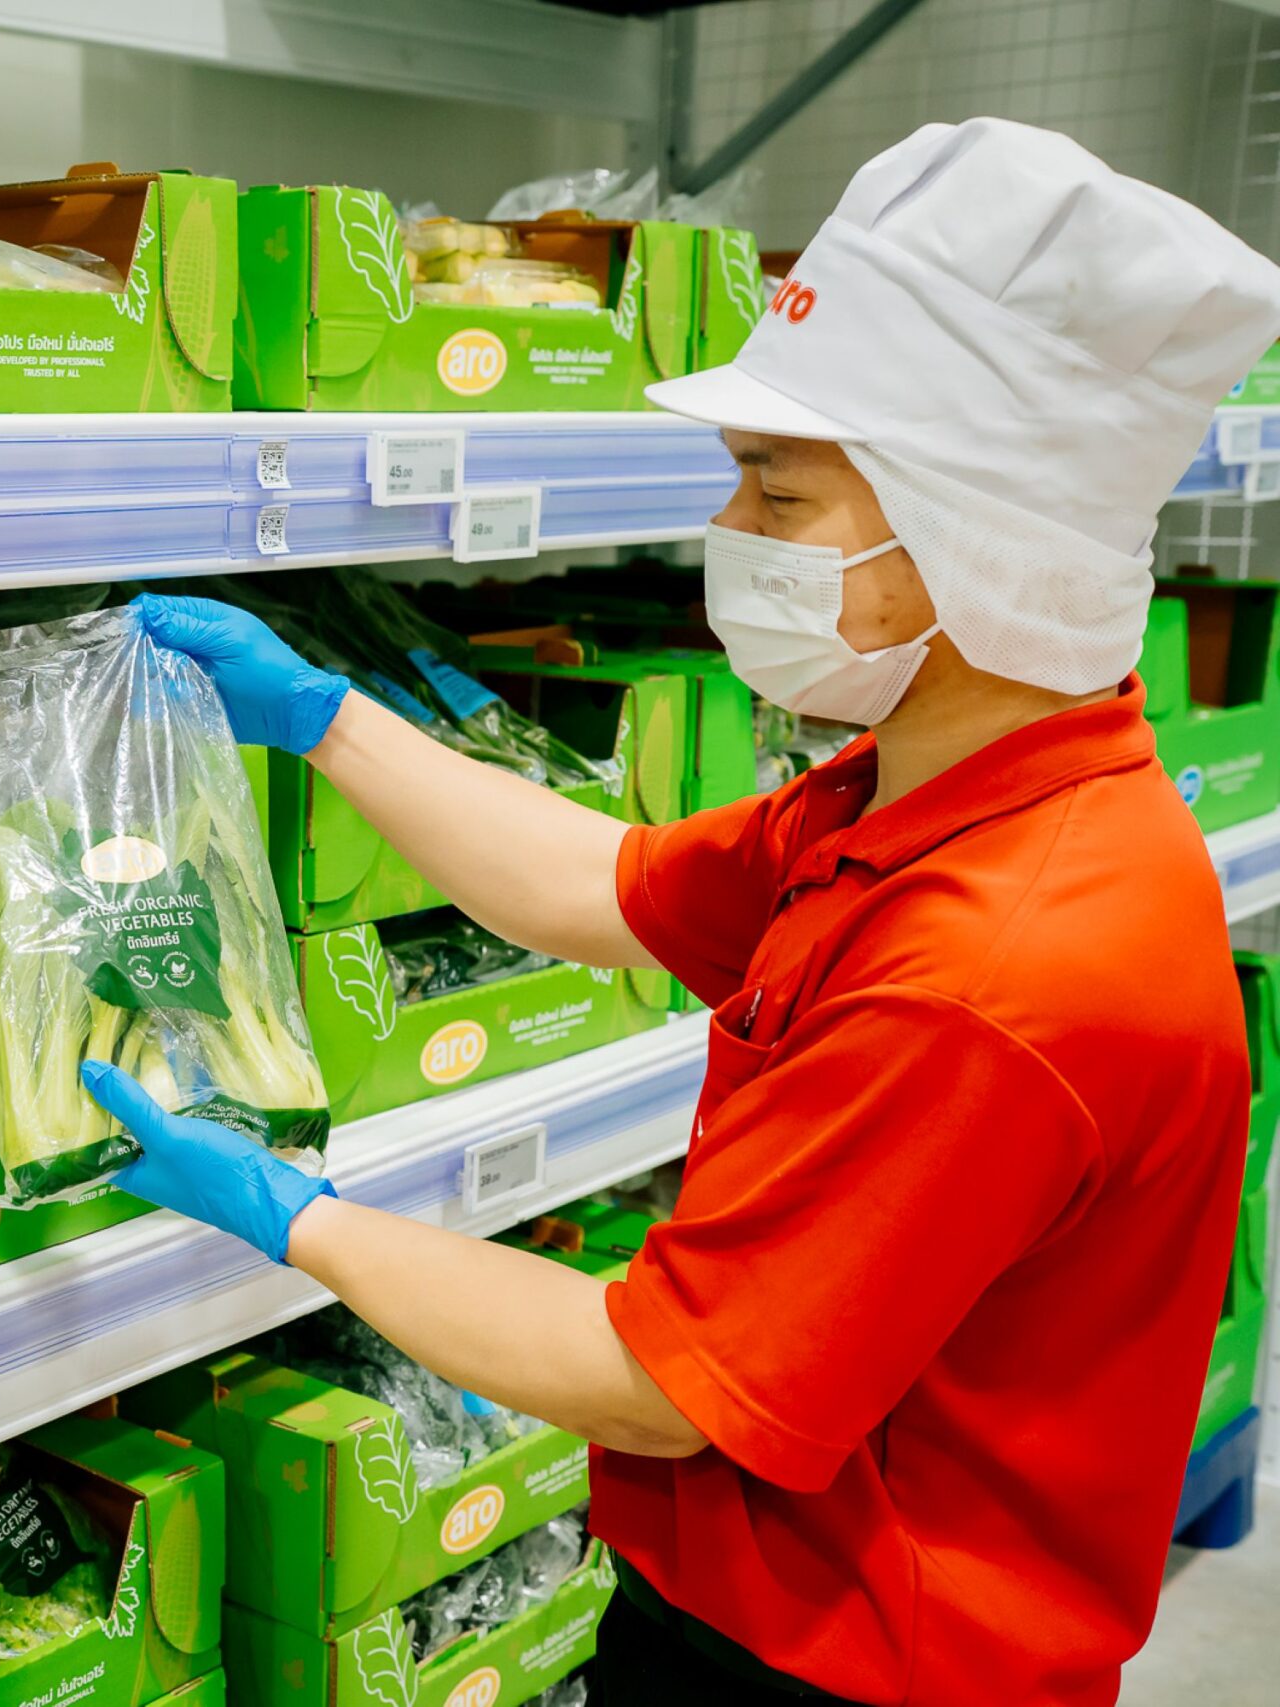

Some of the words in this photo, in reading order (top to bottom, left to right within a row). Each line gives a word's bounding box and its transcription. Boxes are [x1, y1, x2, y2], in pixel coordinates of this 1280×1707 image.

[23, 368, 54, 377] TRUSTED
[55, 369, 65, 378] BY
[67, 369, 81, 378] ALL
[39, 356, 49, 365] BY
[448, 344, 497, 379] aro
[389, 465, 413, 479] 45.00
[78, 900, 131, 921] FRESH
[134, 894, 204, 912] ORGANIC
[100, 911, 195, 933] VEGETABLES
[431, 1031, 478, 1072] aro
[450, 1494, 496, 1541] aro
[449, 1675, 494, 1707] aro
